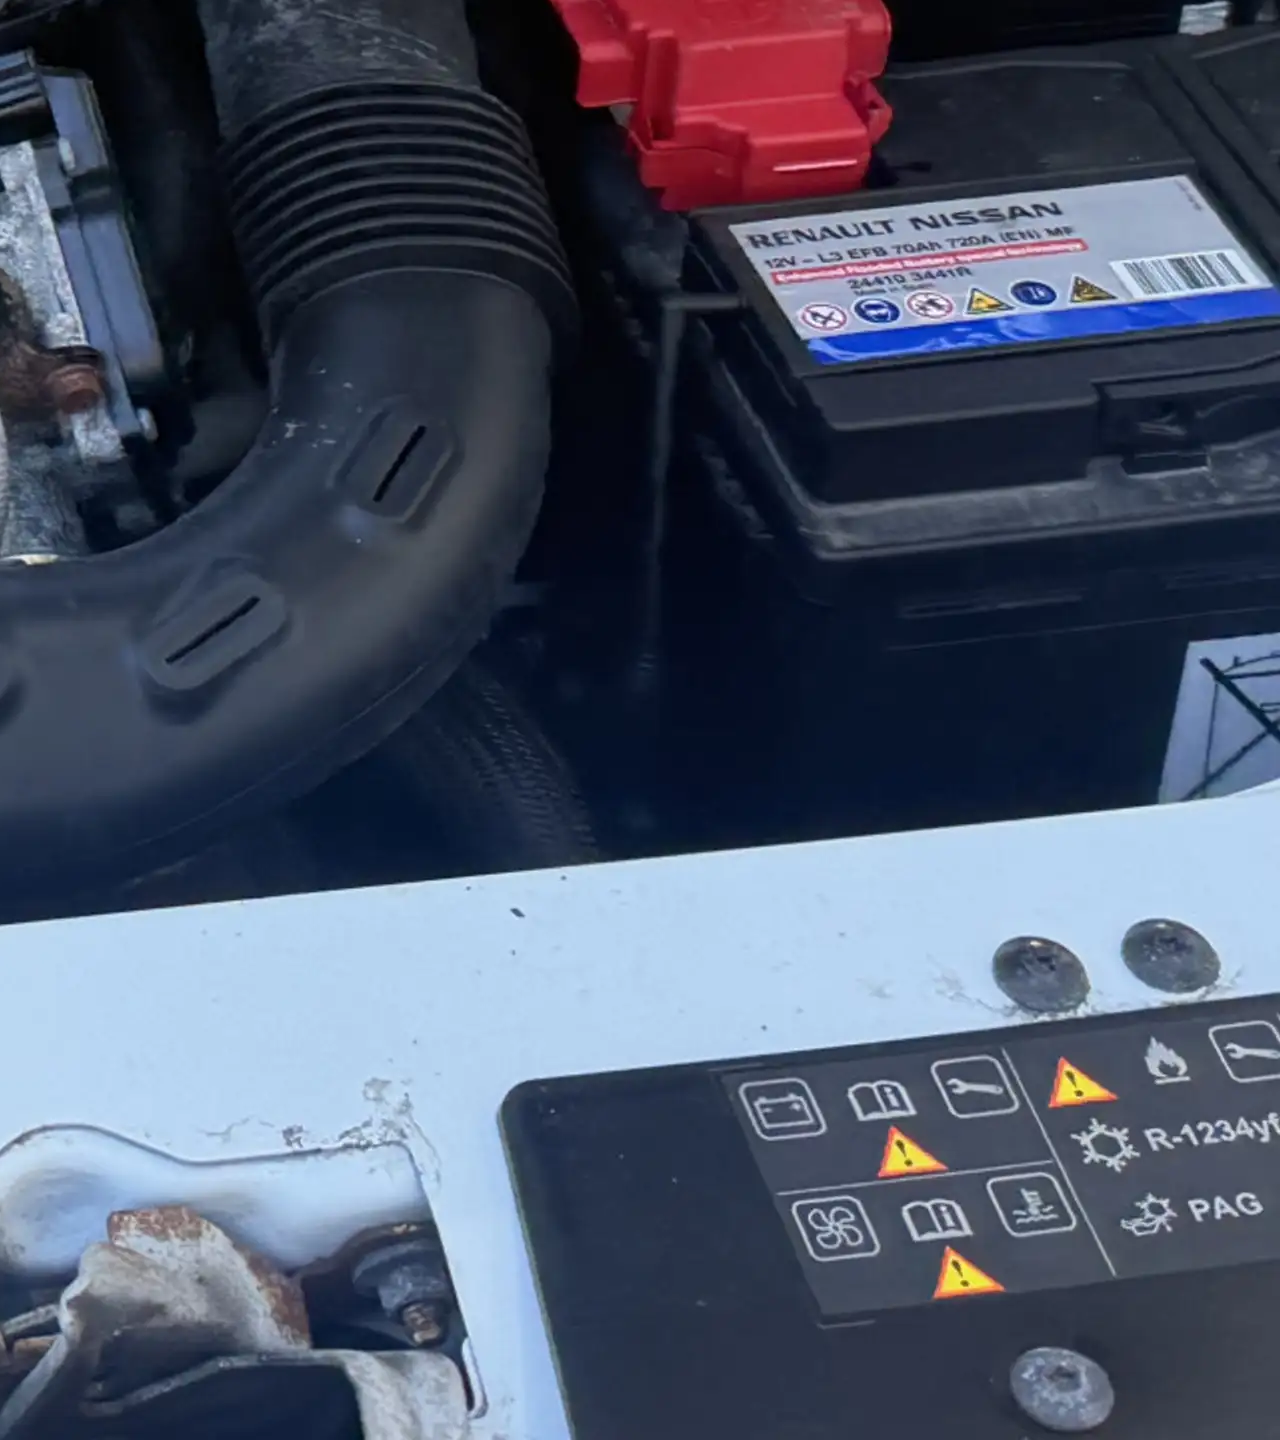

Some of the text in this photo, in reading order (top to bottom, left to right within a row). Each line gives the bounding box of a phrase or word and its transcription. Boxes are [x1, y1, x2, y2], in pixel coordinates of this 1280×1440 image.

[746, 202, 1063, 249] RENAULT NISSAN
[764, 255, 796, 269] 12V
[817, 251, 843, 264] L3
[847, 246, 888, 260] EFB
[891, 241, 942, 255] 70Ah
[945, 234, 996, 249] 720A
[912, 266, 973, 282] 3441R
[1143, 1112, 1280, 1151] R-1234yf
[1187, 1192, 1264, 1222] PAG
